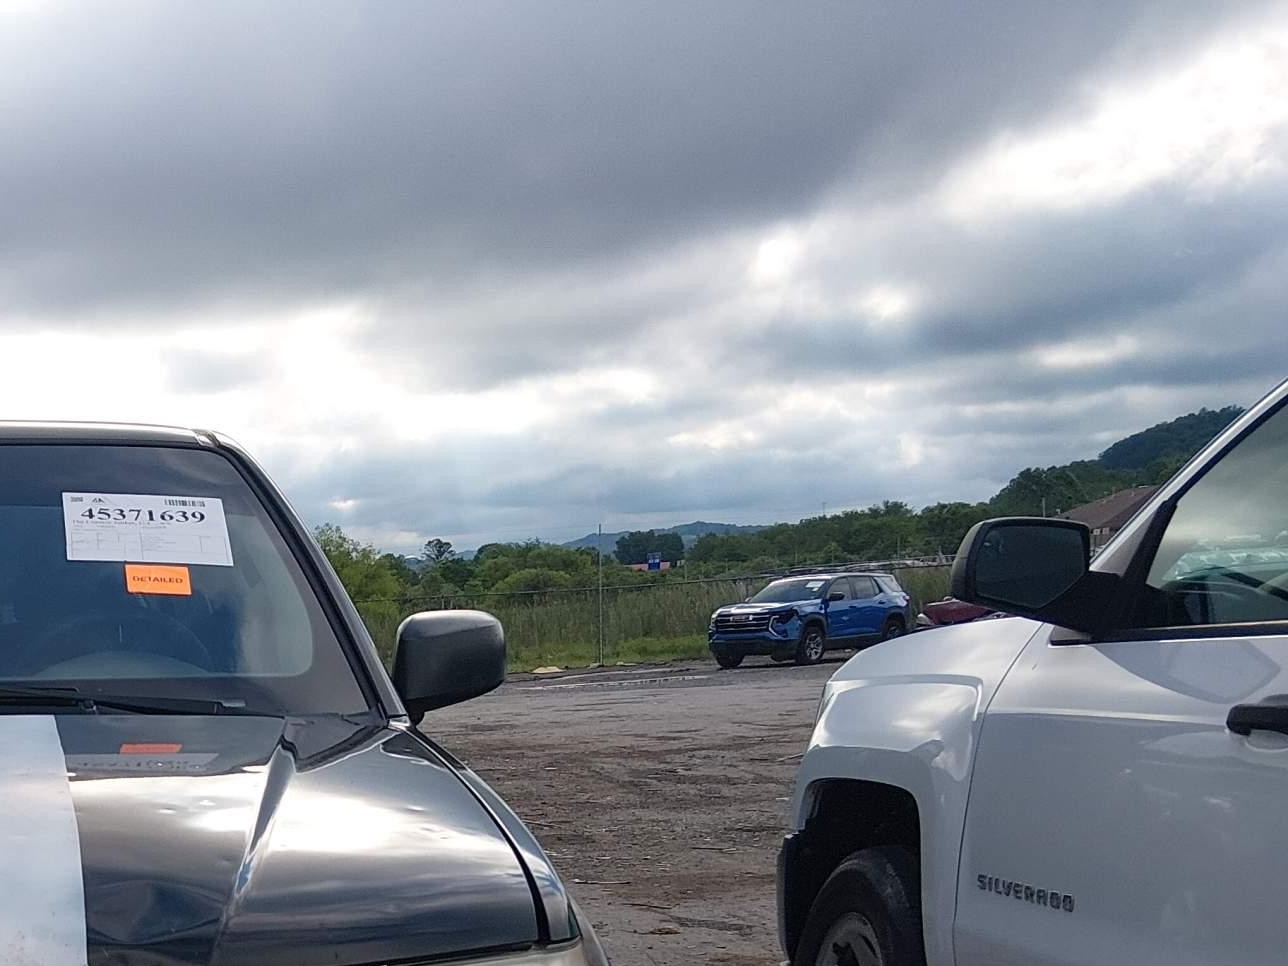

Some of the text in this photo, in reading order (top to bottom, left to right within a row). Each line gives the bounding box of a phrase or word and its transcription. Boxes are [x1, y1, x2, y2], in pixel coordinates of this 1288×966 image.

[80, 507, 205, 523] 45371639
[131, 575, 184, 584] DETAILED
[976, 873, 1075, 913] SILVERADO
